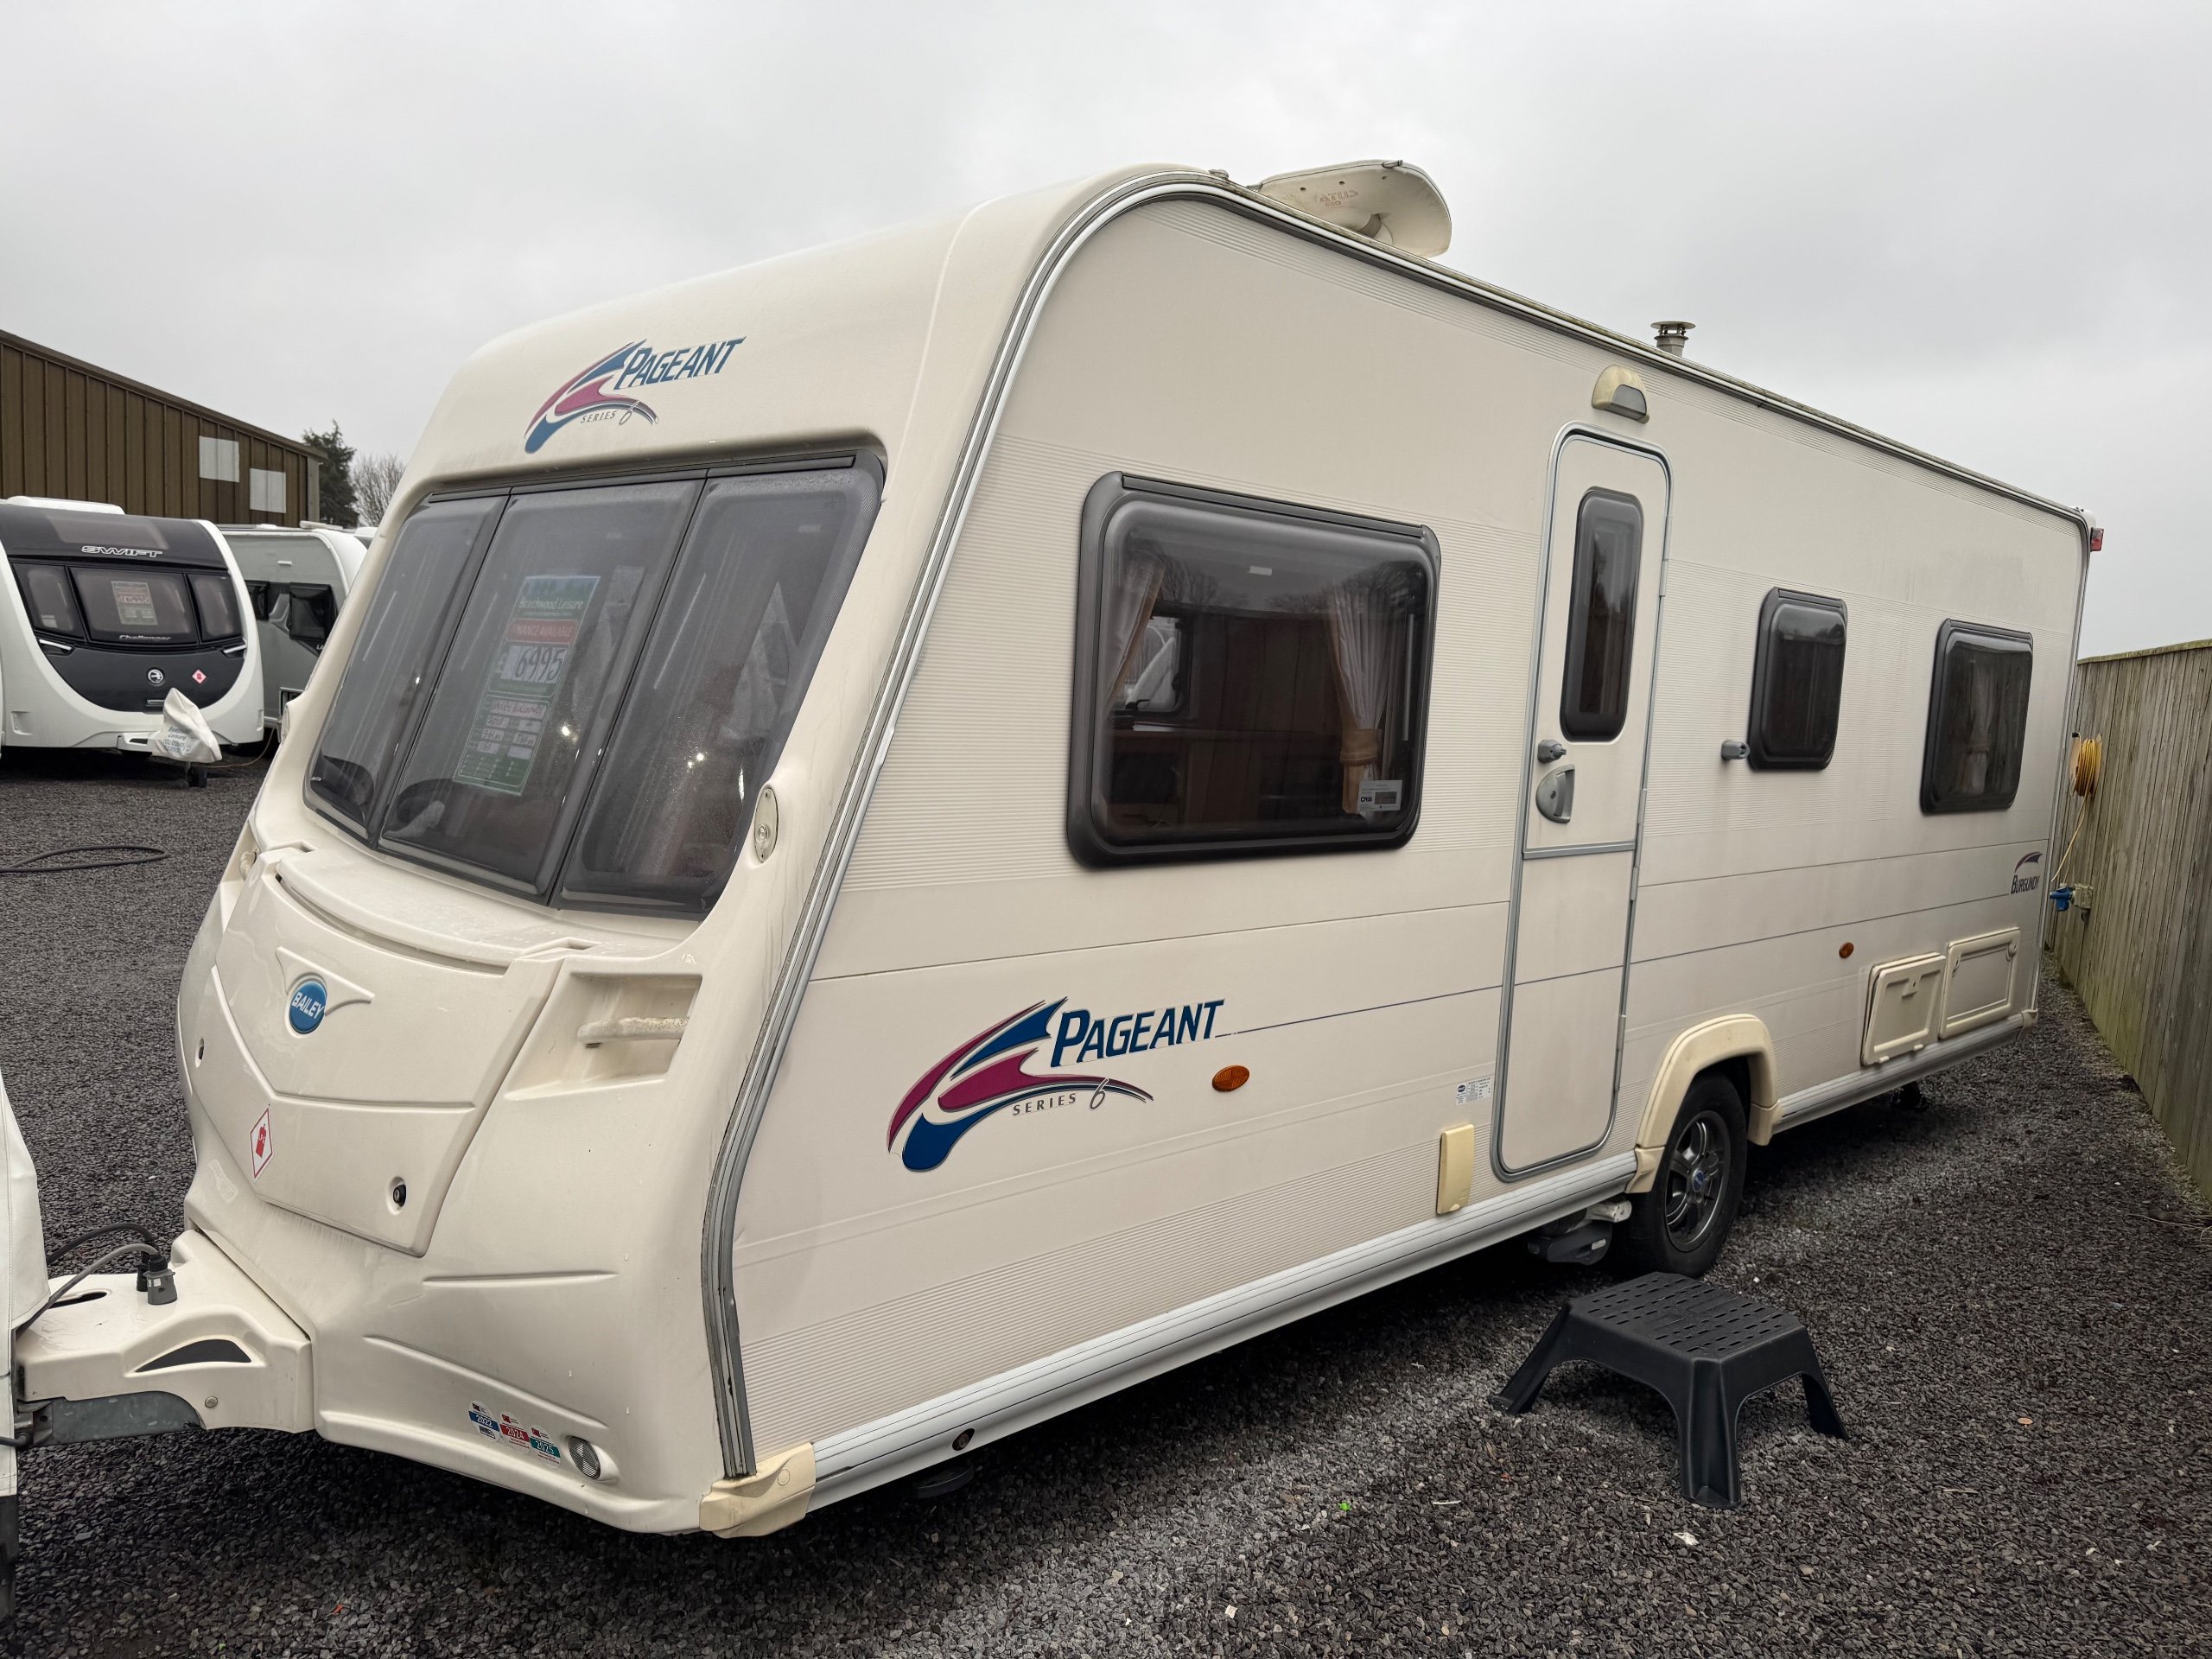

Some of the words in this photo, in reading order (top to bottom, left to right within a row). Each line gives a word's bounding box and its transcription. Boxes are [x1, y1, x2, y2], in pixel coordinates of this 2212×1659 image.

[613, 335, 747, 391] PAGEANT
[580, 410, 616, 424] SERIES
[81, 545, 163, 558] SWIFT
[2010, 874, 2041, 894] BURGUNDY
[291, 991, 326, 1020] BAILEY
[1051, 998, 1225, 1068] PAGEANT
[1012, 1092, 1077, 1116] SERIES
[1090, 1078, 1110, 1110] 6
[475, 1414, 493, 1428] 2022
[505, 1426, 524, 1440] 2024
[535, 1440, 554, 1455] 2025
